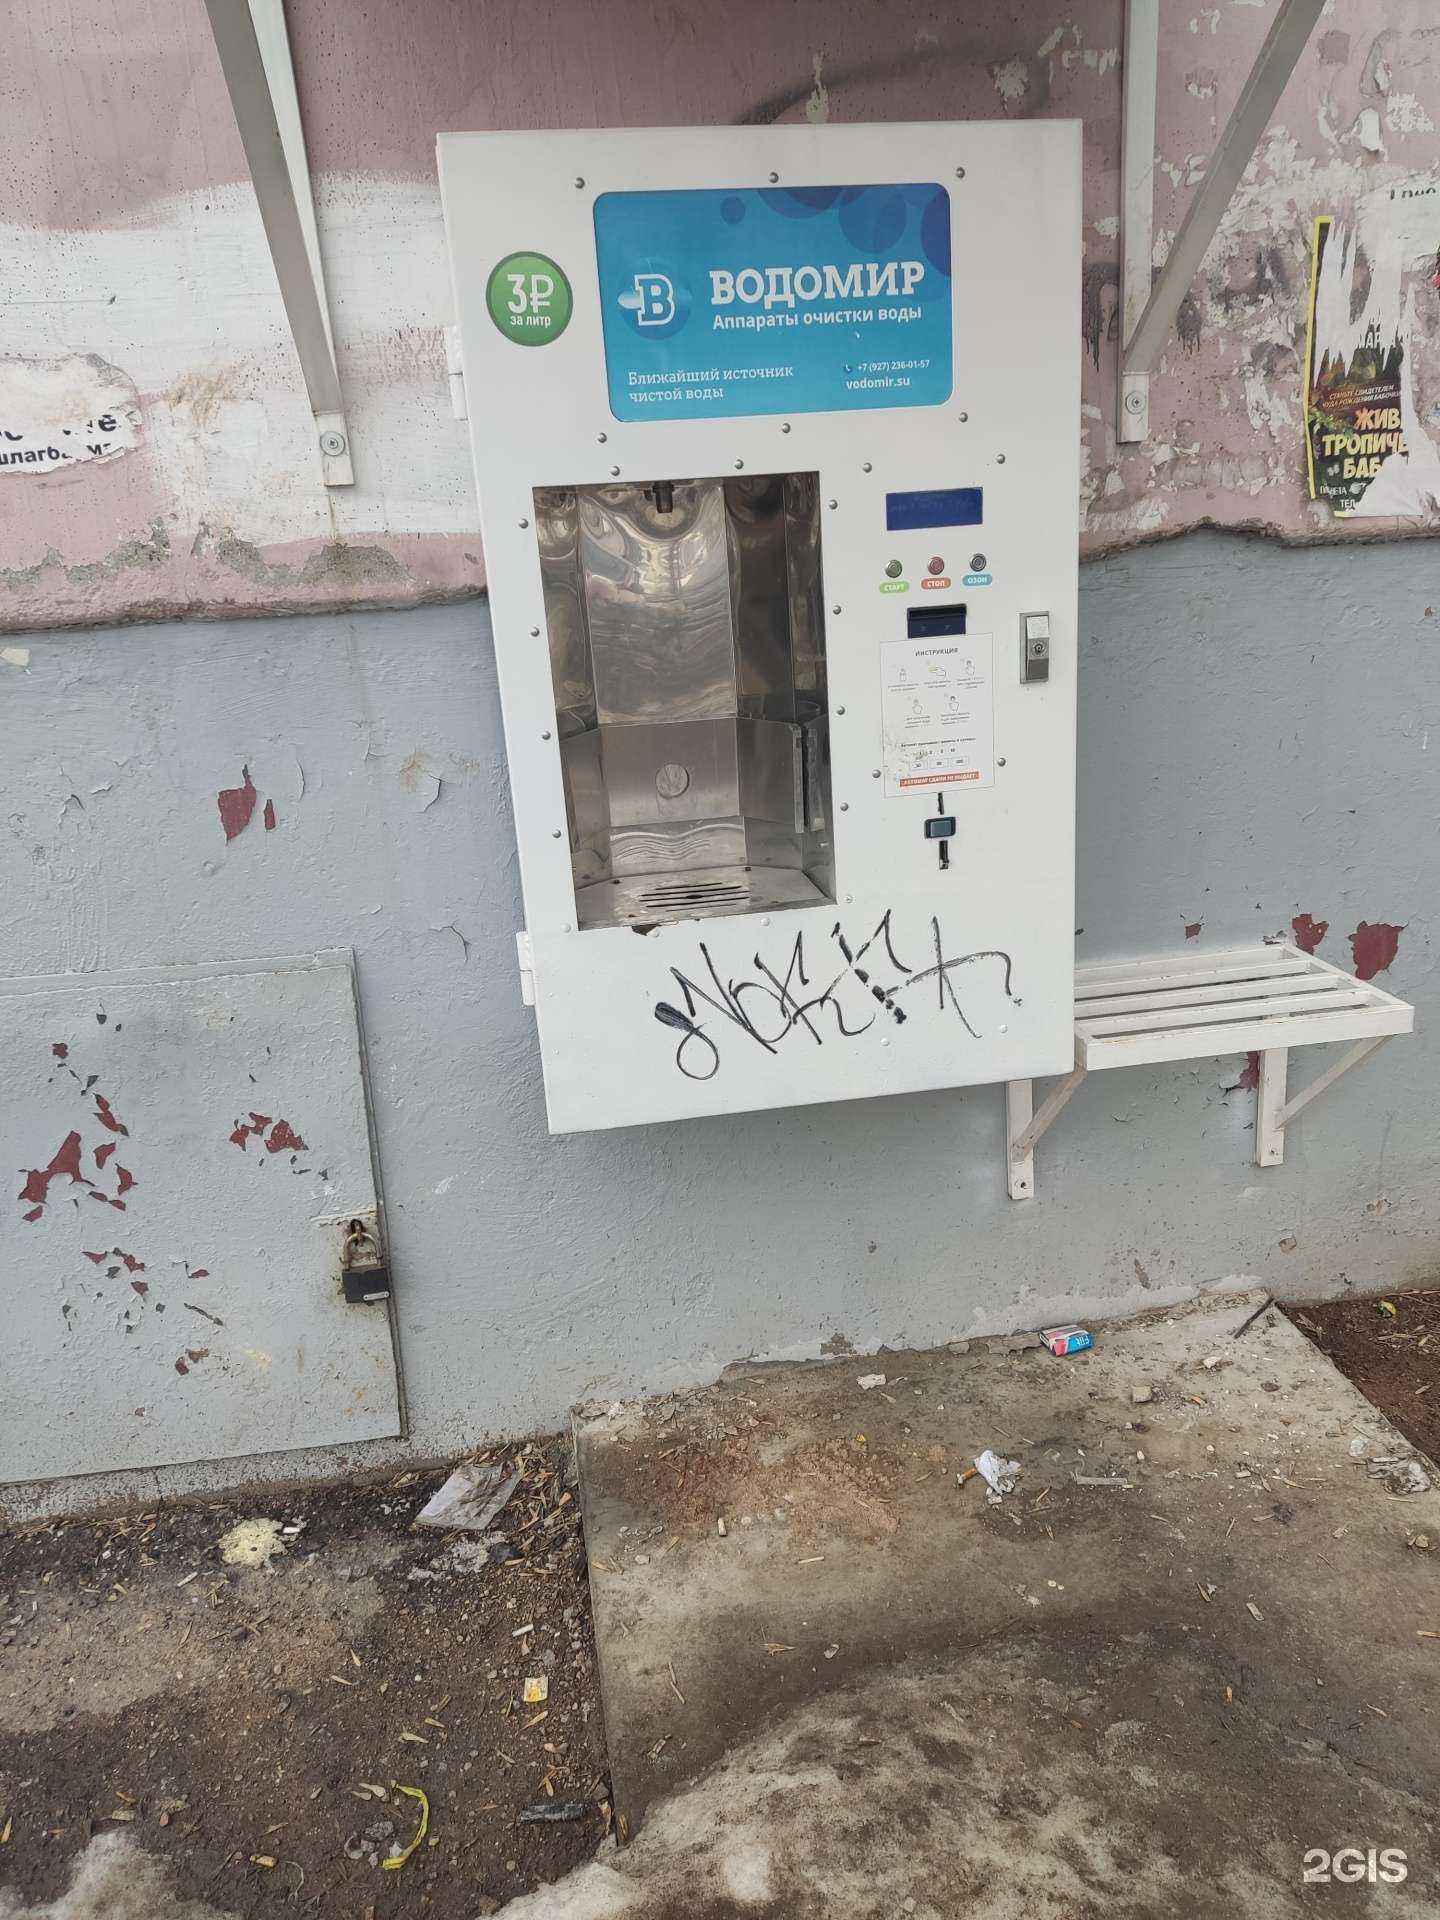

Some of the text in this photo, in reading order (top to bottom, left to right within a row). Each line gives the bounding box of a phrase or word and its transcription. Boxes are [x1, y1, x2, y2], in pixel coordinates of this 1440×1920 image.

[709, 260, 925, 310] ВОДОМИР
[510, 315, 552, 329] за литр
[713, 306, 922, 332] Аппараты очистки воды
[858, 363, 868, 372] +7
[628, 366, 793, 386] Ближайший источник
[846, 376, 910, 390] vodomir.su
[629, 387, 724, 403] чистой воды
[927, 580, 946, 588] СТОП
[915, 647, 959, 656] ИНСТРУКЦИЯ
